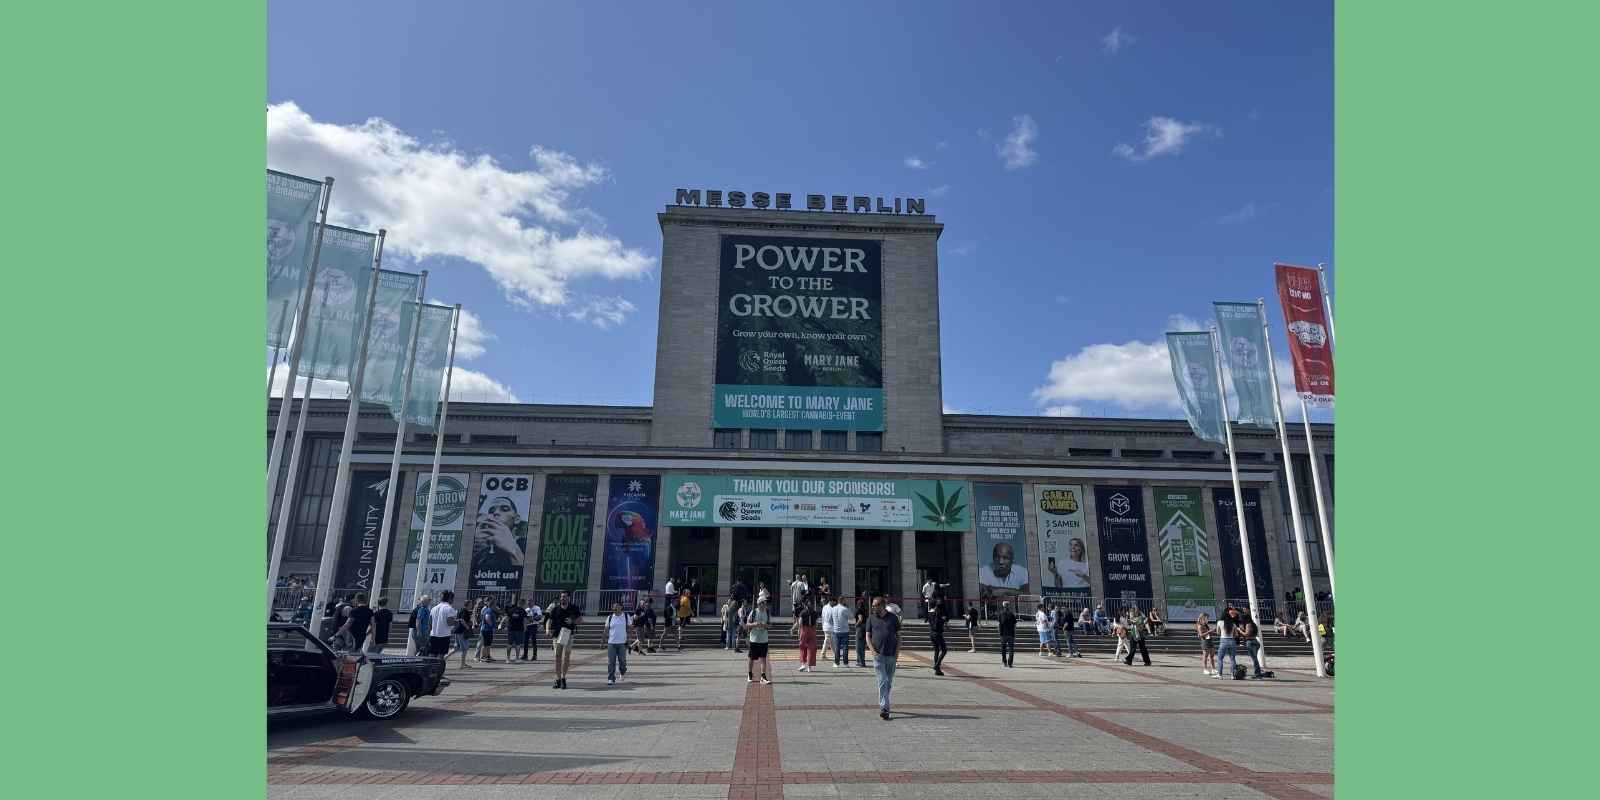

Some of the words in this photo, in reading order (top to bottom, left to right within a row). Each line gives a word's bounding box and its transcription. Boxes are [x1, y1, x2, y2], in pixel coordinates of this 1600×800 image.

[675, 188, 792, 209] MESSE
[806, 194, 926, 214] BERLIN
[734, 244, 869, 273] POWER
[768, 276, 794, 290] TO
[798, 277, 833, 291] THE
[729, 293, 872, 320] GROWER
[733, 329, 757, 338] Grow
[757, 332, 780, 341] your
[800, 332, 827, 341] know
[826, 333, 847, 342] your
[763, 351, 785, 360] Royal
[763, 358, 787, 366] Queen
[804, 354, 833, 367] MARY
[834, 354, 860, 368] JANE
[724, 393, 785, 409] WELCOME
[788, 395, 801, 410] TO
[805, 396, 840, 411] MARY
[843, 397, 873, 412] JANE
[773, 410, 800, 420] LARGEST
[486, 477, 529, 491] OCB
[733, 479, 773, 493] THANK
[776, 479, 799, 494] YOU
[802, 480, 826, 495] OUR
[829, 480, 896, 496] SPONSORS!
[1042, 489, 1074, 501] GANJA
[740, 501, 760, 510] Royal
[740, 508, 763, 516] Queen
[1040, 499, 1079, 511] FARMER
[544, 513, 591, 545] LOVE
[1052, 520, 1080, 528] SAMEN
[360, 504, 381, 564] INFINITY
[542, 545, 587, 561] GROWING
[1107, 553, 1130, 562] GROW
[1131, 553, 1144, 562] BIG
[356, 567, 371, 590] AC
[474, 569, 501, 579] Joint
[503, 570, 519, 579] us!
[541, 561, 585, 585] GREEN
[1108, 573, 1128, 581] GROW
